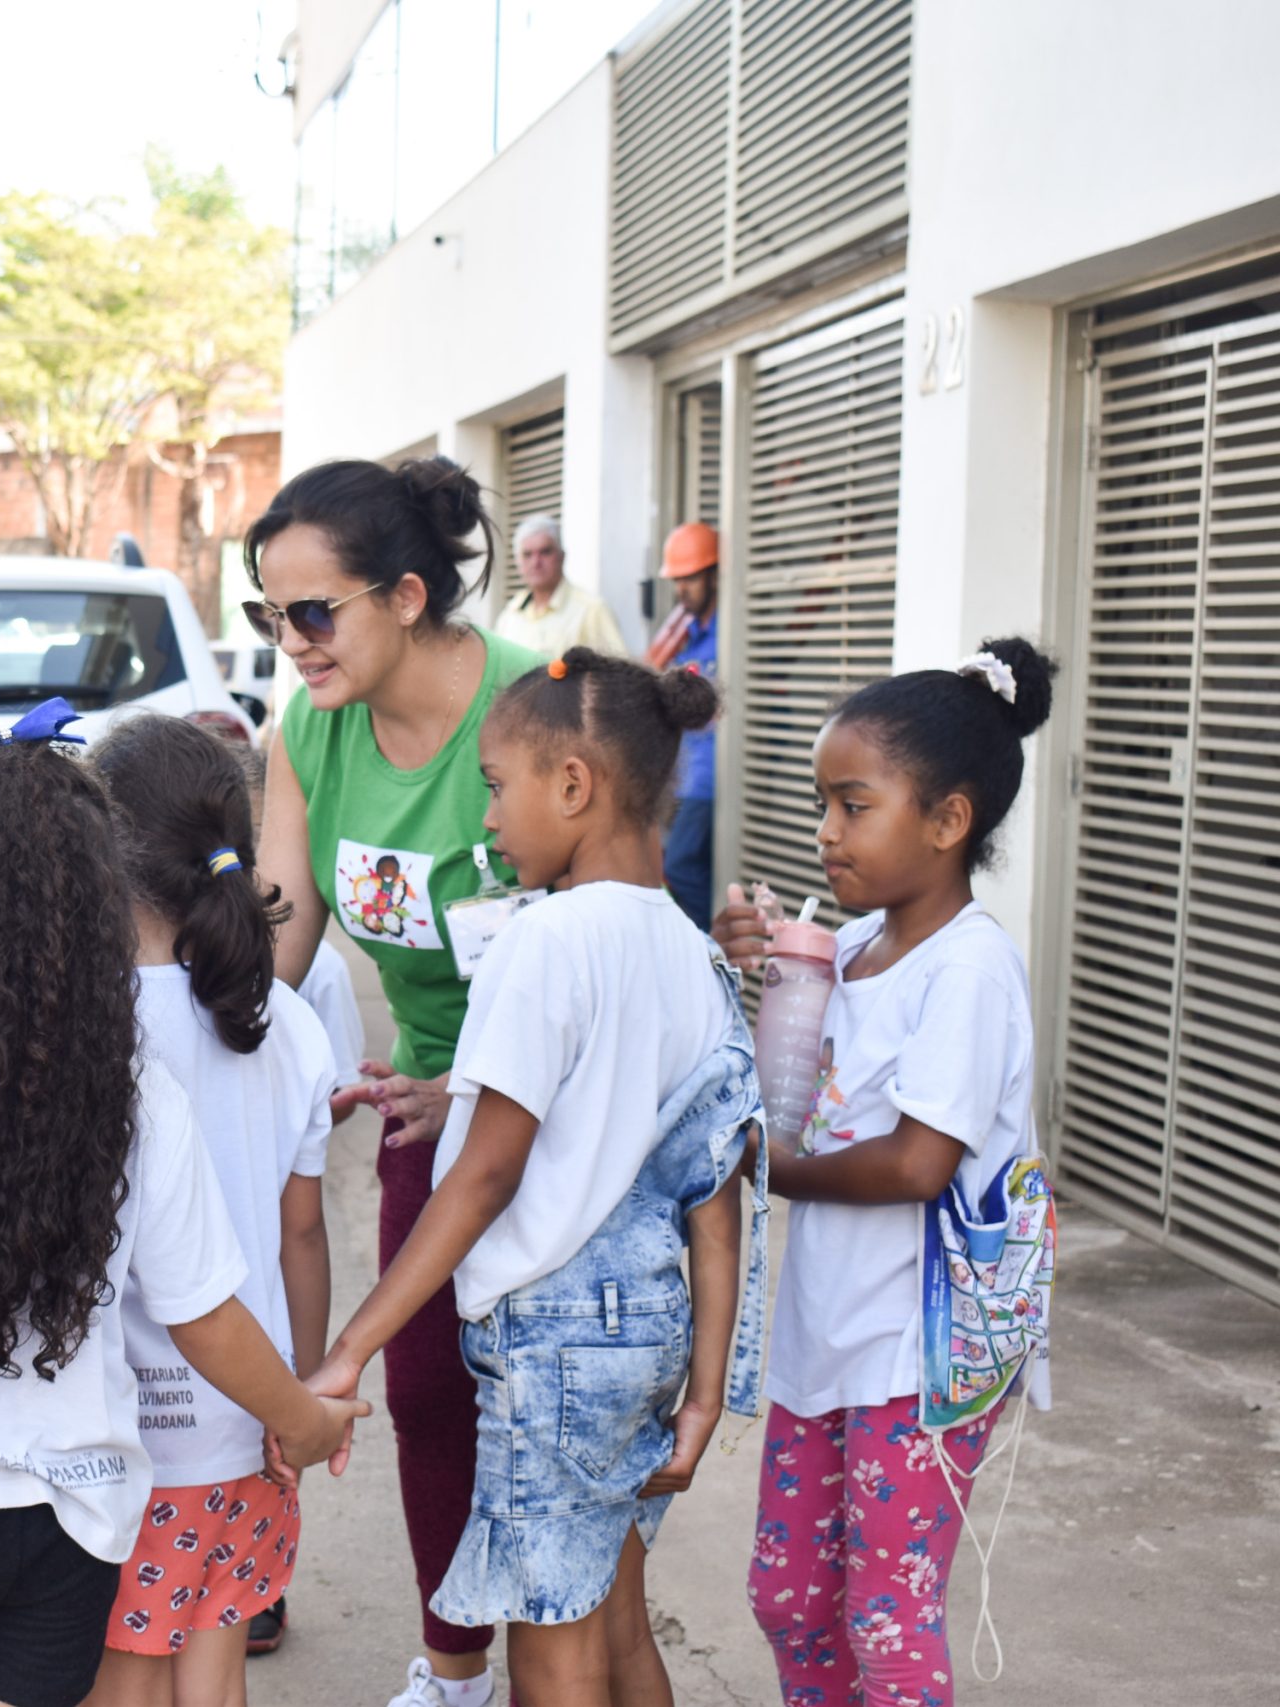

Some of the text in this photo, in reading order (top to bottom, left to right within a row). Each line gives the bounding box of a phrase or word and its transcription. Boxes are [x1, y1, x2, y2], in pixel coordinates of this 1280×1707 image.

[918, 306, 963, 398] 22
[177, 1367, 190, 1381] DE
[46, 1455, 127, 1484] MARIANA
